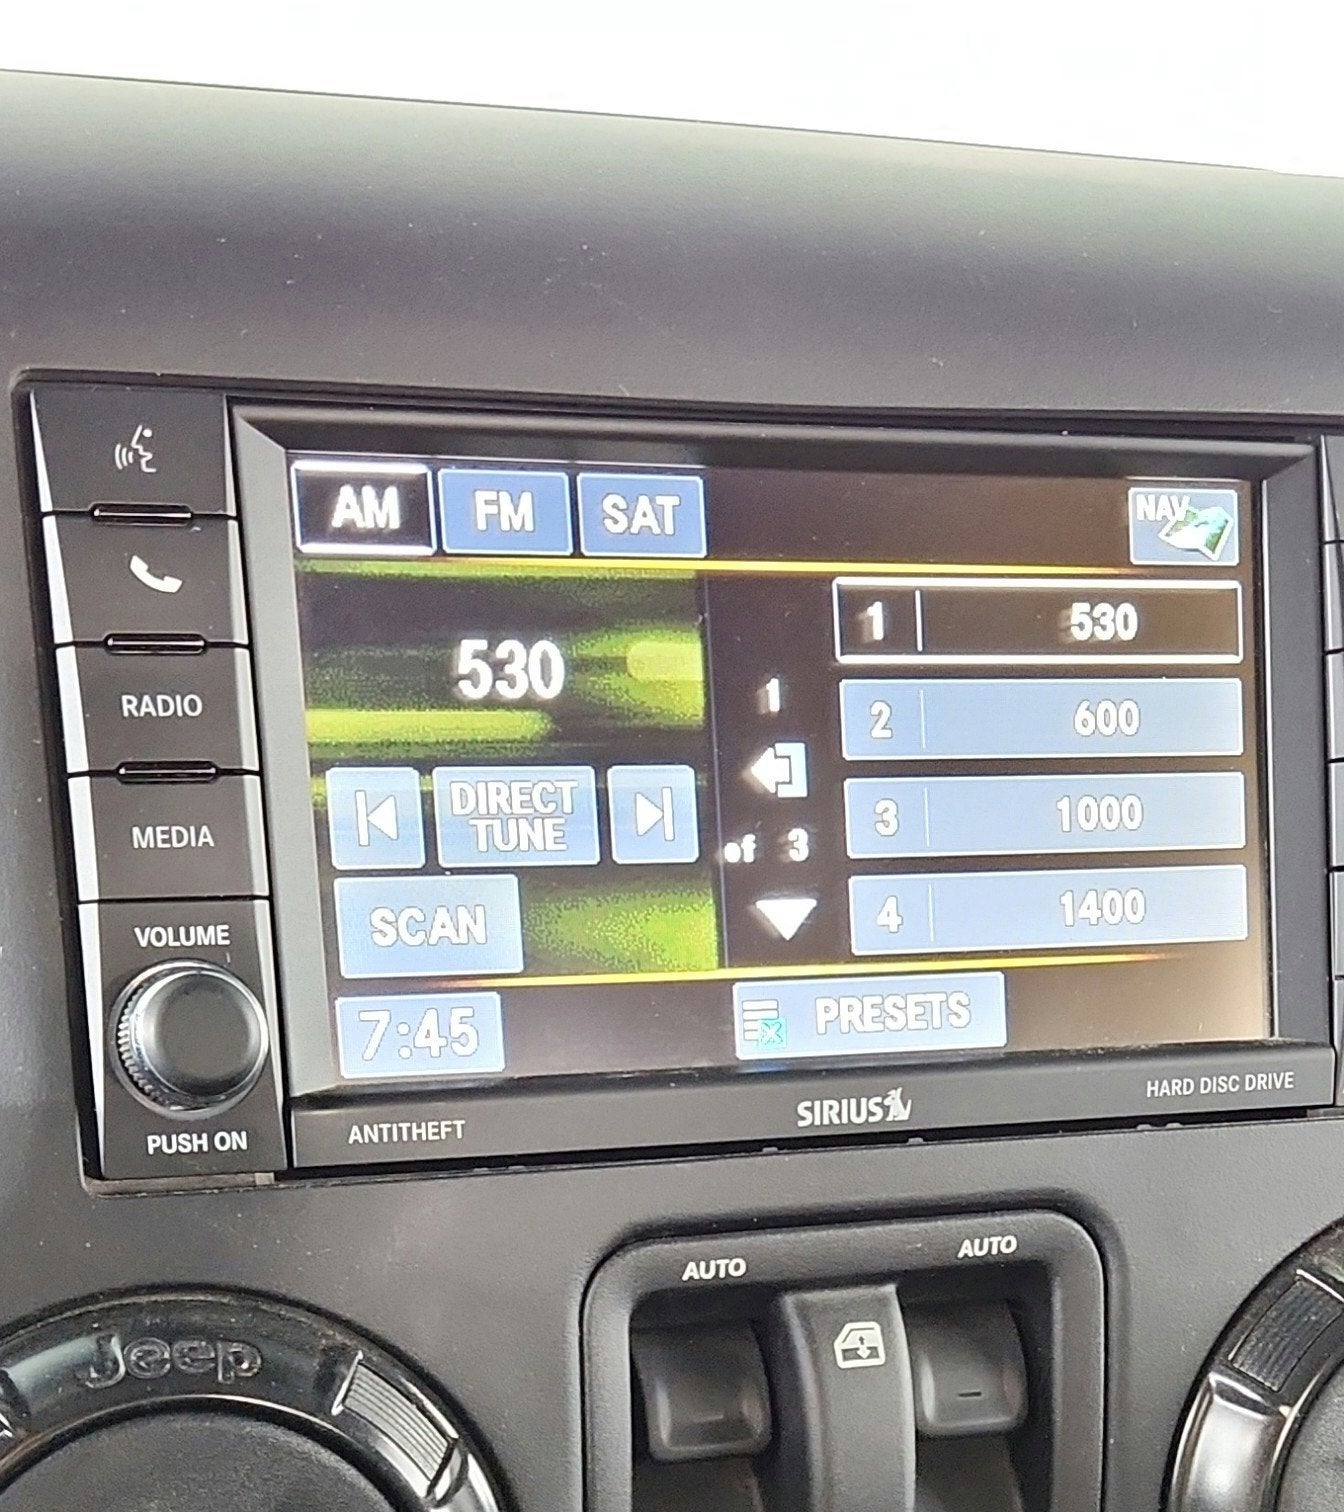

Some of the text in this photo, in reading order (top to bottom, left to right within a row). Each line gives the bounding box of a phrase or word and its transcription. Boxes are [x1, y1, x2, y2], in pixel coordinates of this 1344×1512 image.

[332, 486, 400, 531] AM
[475, 491, 534, 533] FM
[602, 496, 680, 535] SAT
[1136, 494, 1191, 523] NAV
[865, 601, 1139, 642] 1 530
[457, 639, 564, 700] 530
[122, 694, 203, 718] RADIO
[762, 679, 781, 712] 1
[869, 700, 1141, 740] 2 600
[450, 780, 578, 816] DIRECT
[874, 795, 1143, 837] 3 1000
[132, 826, 214, 849] MEDIA
[470, 817, 568, 854] TUNE
[723, 829, 809, 864] of 3
[369, 904, 487, 948] SCAN
[876, 889, 1147, 934] 4 1400
[134, 925, 230, 948] VOLUME
[815, 992, 972, 1035] PRESETS
[358, 1008, 480, 1061] 7:45
[1146, 1071, 1295, 1099] HARD DISC DRIVE
[796, 1095, 885, 1128] SIRIUS
[147, 1131, 248, 1155] PUSH ON
[348, 1119, 466, 1145] ANTITHEFT
[958, 1235, 1018, 1258] AUTO
[682, 1257, 747, 1282] AUTO
[76, 1331, 262, 1390] Jeep
